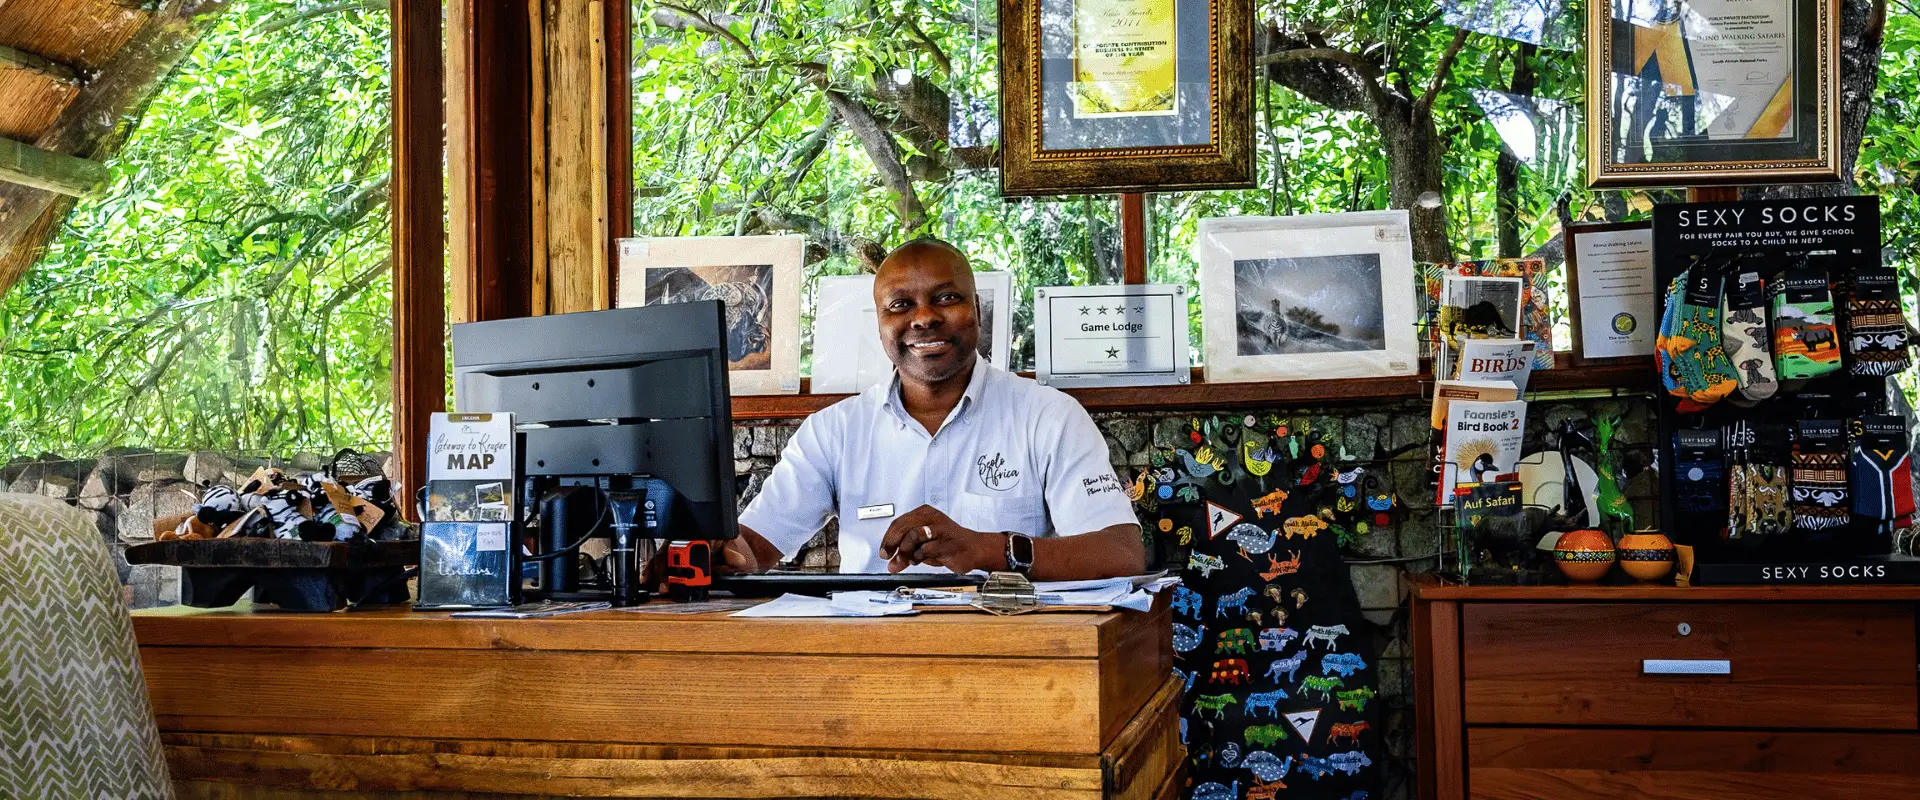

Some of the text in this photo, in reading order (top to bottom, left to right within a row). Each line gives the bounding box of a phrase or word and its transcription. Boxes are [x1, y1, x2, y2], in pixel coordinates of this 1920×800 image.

[1678, 204, 1856, 227] SEXY SOCKS
[1698, 232, 1723, 240] EVERY
[1822, 228, 1855, 236] SCHOOL
[1762, 238, 1787, 246] CHILD
[1080, 322, 1143, 333] Game Lodge
[1470, 356, 1526, 373] BIRDS
[1463, 409, 1516, 420] Faansie's
[1457, 418, 1520, 432] Bird Book 2
[468, 438, 477, 450] to
[478, 433, 507, 453] Kruger
[447, 453, 495, 470] MAP
[986, 467, 1019, 487] Africa
[1464, 495, 1515, 510] Auf Safari
[1762, 565, 1885, 579] SEXY SOCKS
